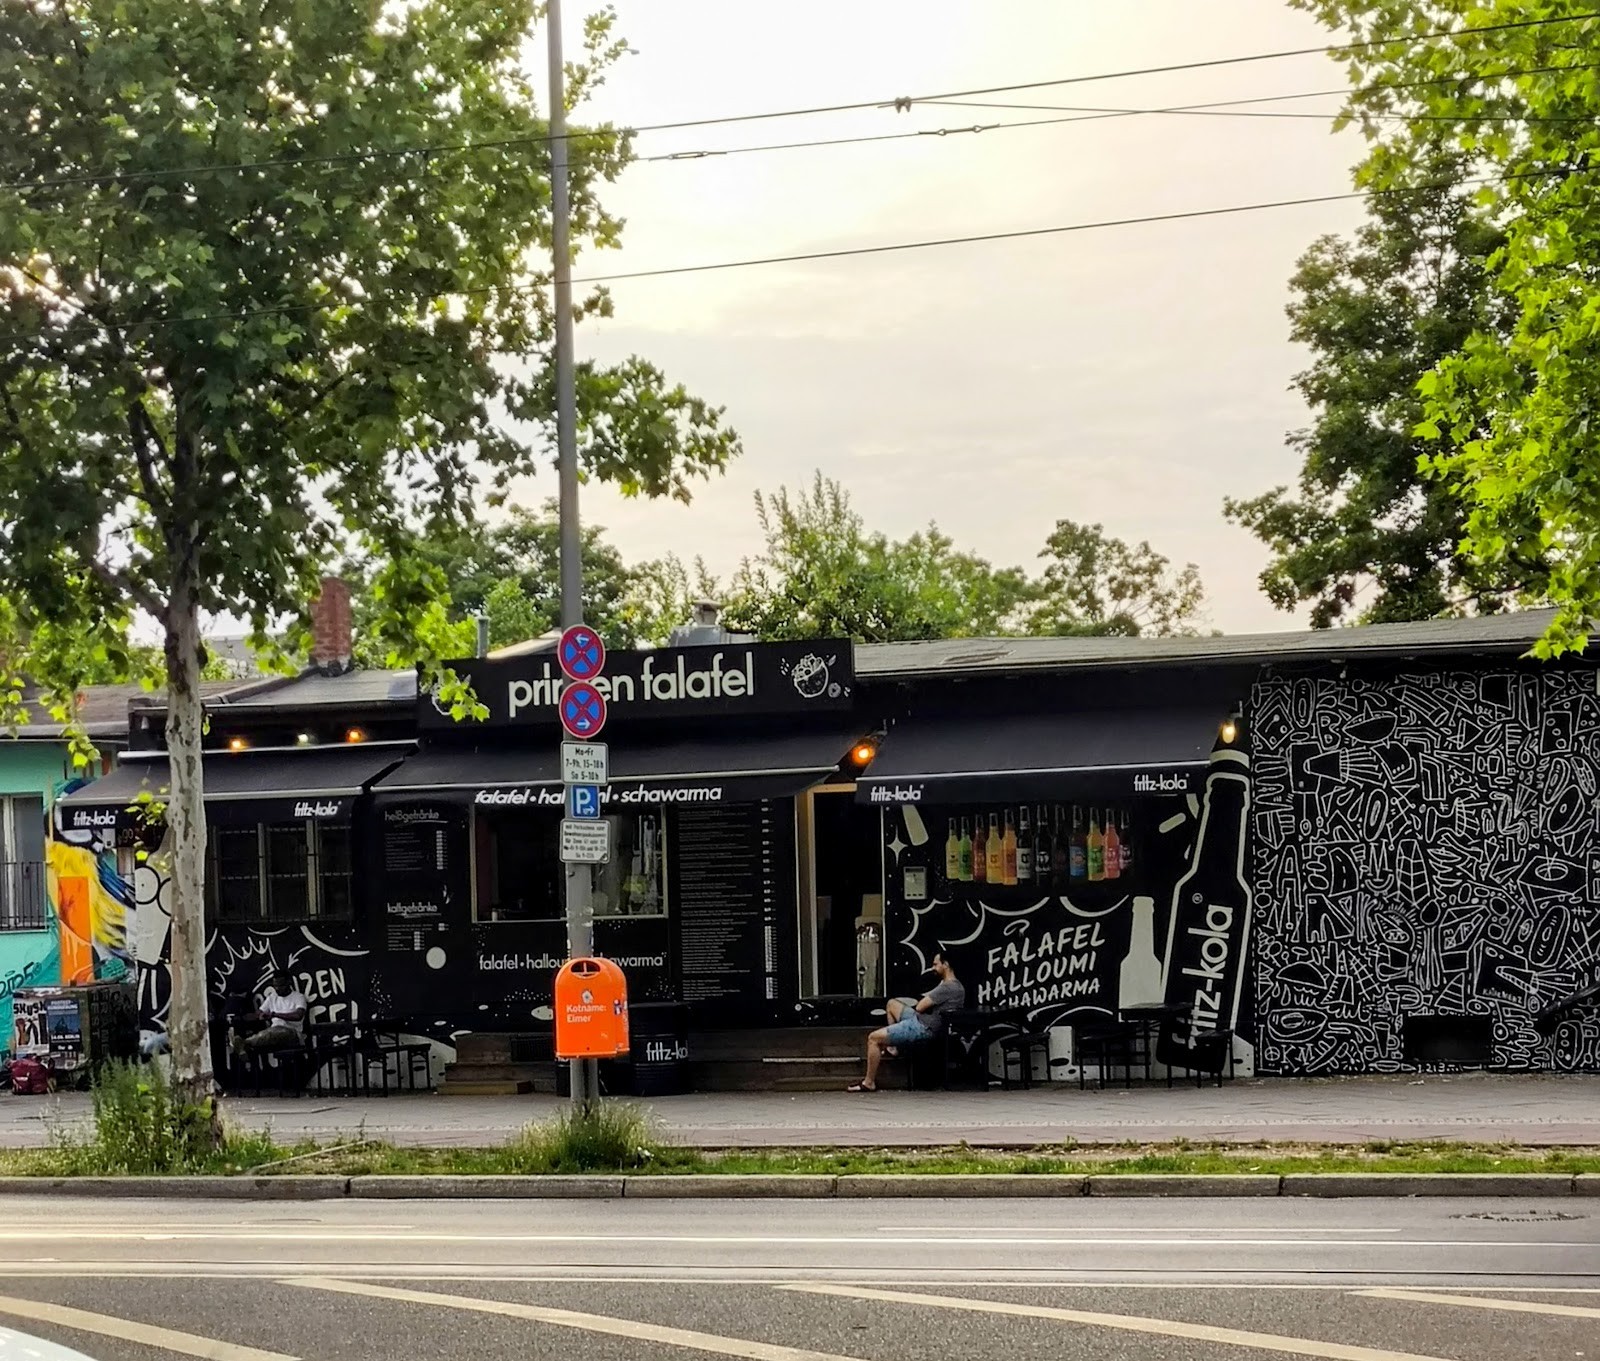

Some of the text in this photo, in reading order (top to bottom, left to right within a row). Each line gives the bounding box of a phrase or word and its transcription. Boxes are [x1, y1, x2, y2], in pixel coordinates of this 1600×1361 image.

[508, 651, 755, 718] prinen falafel
[1134, 774, 1187, 791] fritz-kola
[475, 788, 530, 804] falafel
[621, 784, 722, 803] schawarma
[870, 785, 921, 801] fritz-kola
[987, 922, 1105, 973] FALAFEL
[479, 954, 518, 970] falafel
[978, 951, 1096, 1004] HALLOUMI
[566, 1004, 607, 1013] Kotname:
[566, 1014, 592, 1023] Eimer
